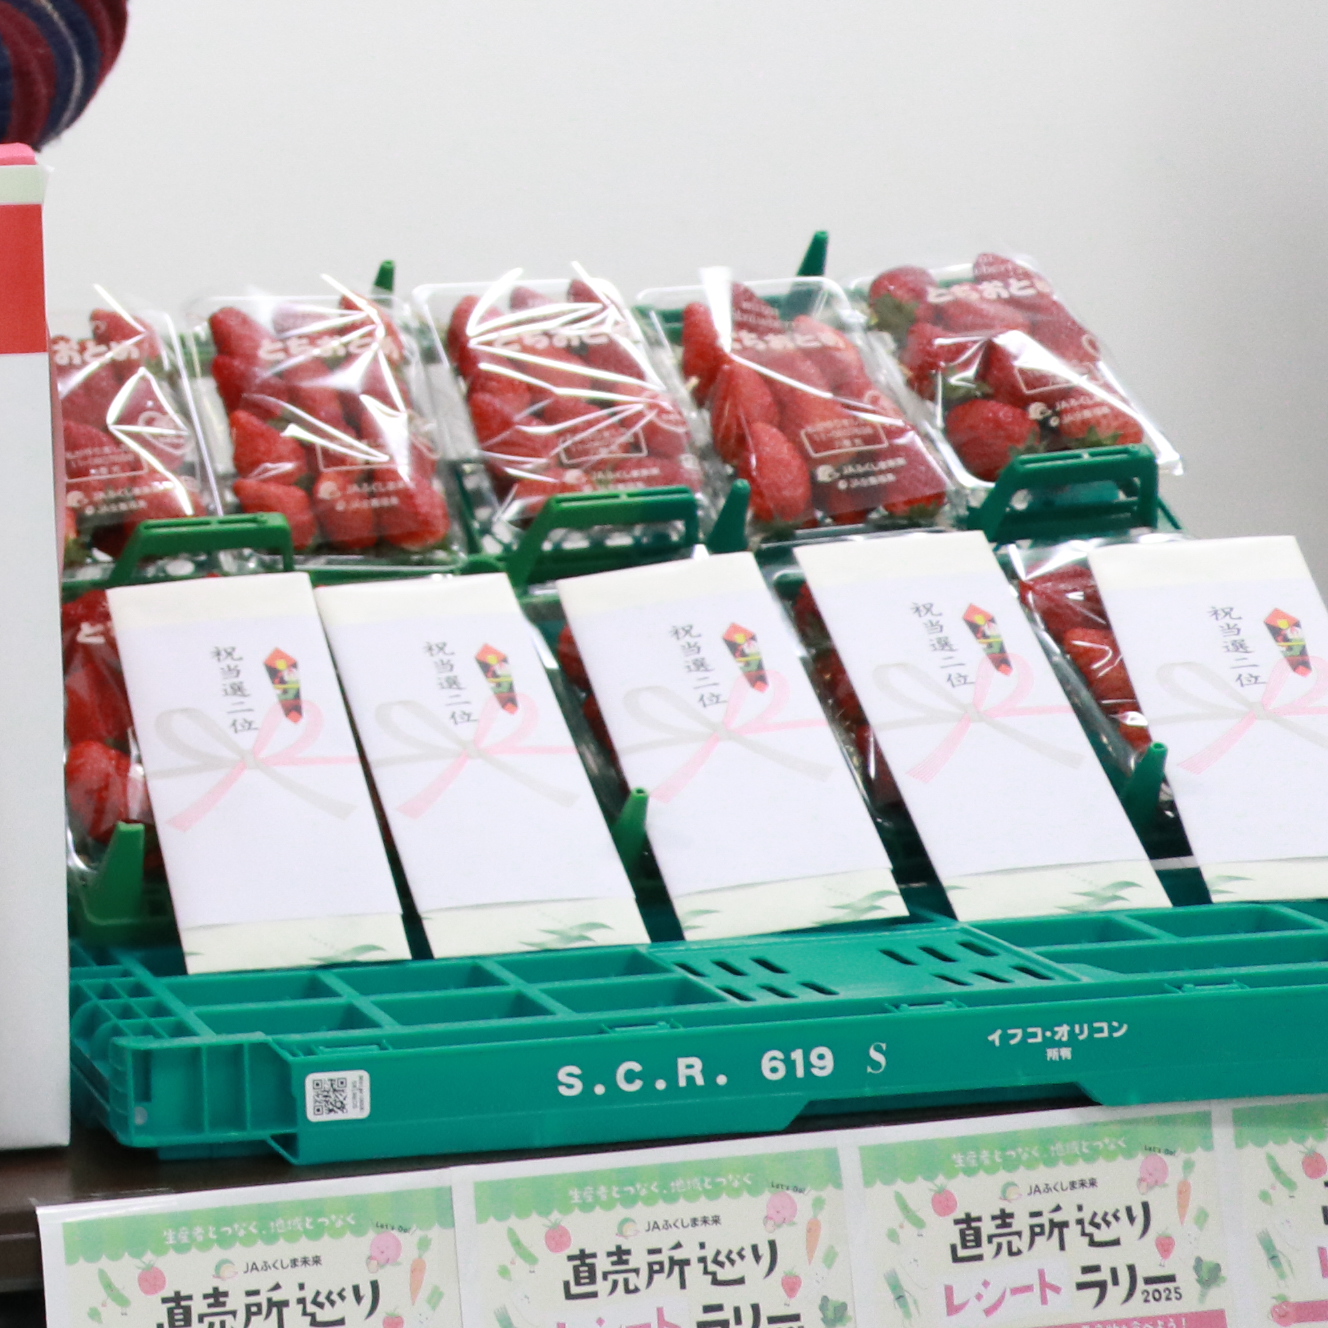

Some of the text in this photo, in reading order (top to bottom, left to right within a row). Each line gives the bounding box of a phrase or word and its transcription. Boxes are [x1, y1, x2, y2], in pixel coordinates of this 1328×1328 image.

[670, 624, 728, 708] 祝当選二位
[909, 601, 976, 689] 祝当選二位
[1208, 605, 1267, 689] 祝当選二位
[211, 645, 259, 734] 祝当選二位
[423, 639, 478, 726] 祝当選二位
[760, 1046, 834, 1081] 619
[866, 1041, 887, 1074] S
[1027, 1178, 1099, 1196] JAふくしま未来
[644, 1214, 722, 1232] JAふくしま未来
[949, 1200, 1153, 1264] 直売所巡り
[243, 1255, 324, 1274] JAふくしま未来
[562, 1239, 778, 1301] 直売所巡り
[1141, 1286, 1183, 1304] 2025
[156, 1279, 381, 1328] 直売所巡り
